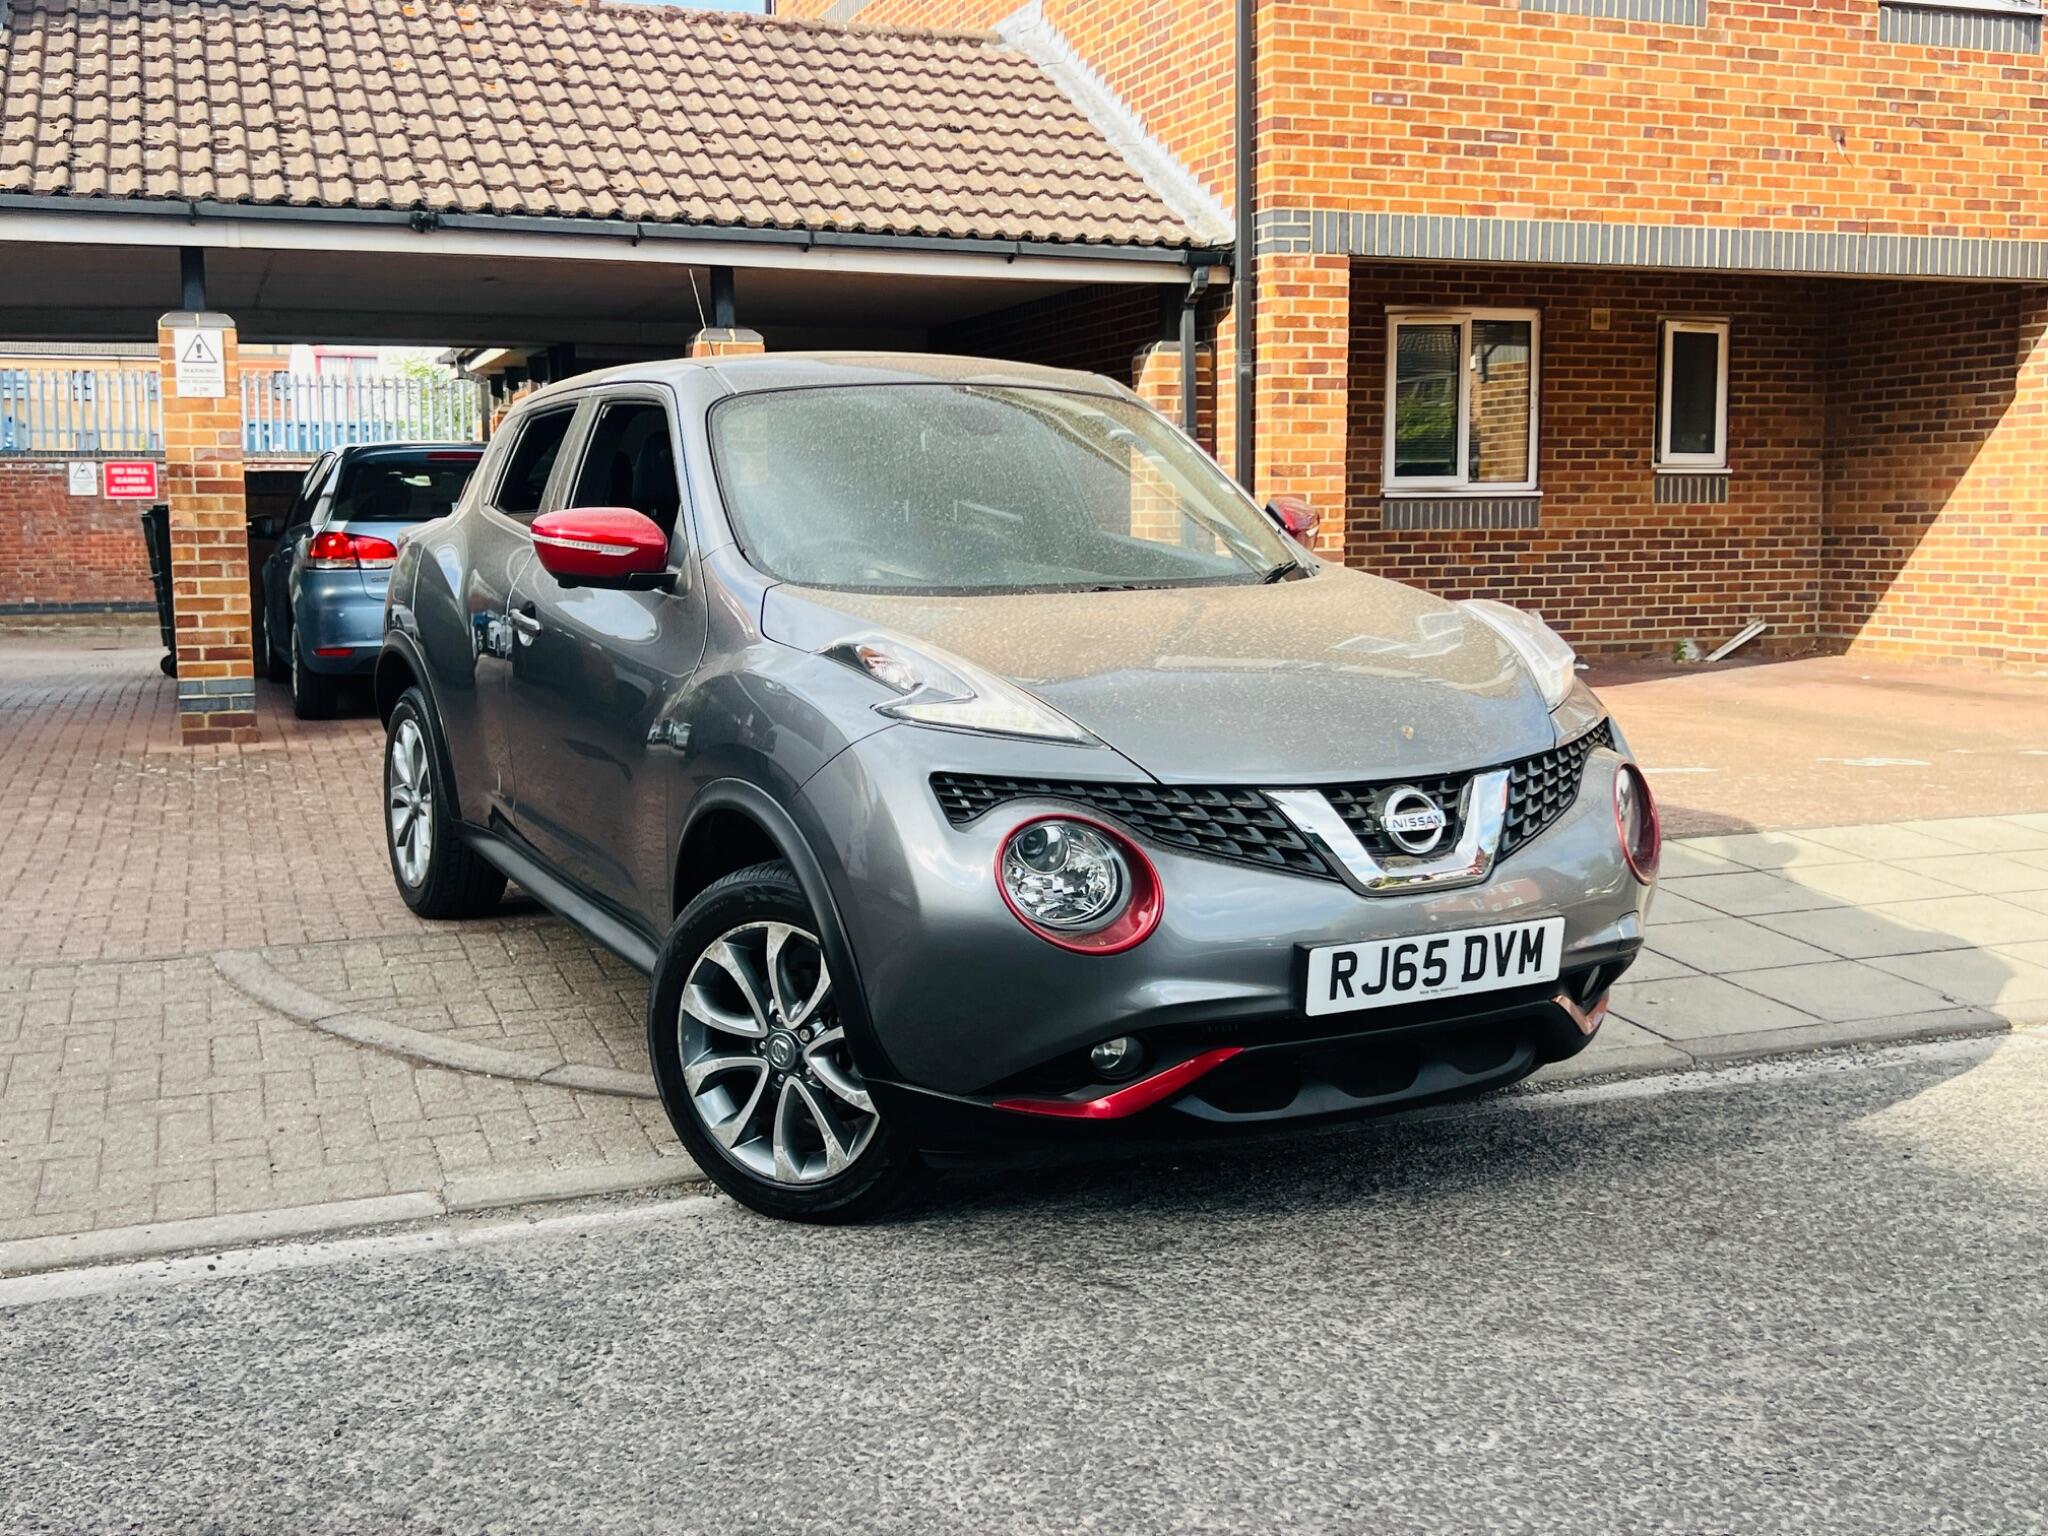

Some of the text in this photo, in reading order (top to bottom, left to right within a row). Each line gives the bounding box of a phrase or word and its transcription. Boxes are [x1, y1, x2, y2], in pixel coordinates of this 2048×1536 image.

[111, 467, 149, 475] NO BALL
[115, 476, 146, 484] GAMES
[1392, 815, 1442, 828] NISSAN
[1329, 926, 1545, 1000] RJ65 DVM
